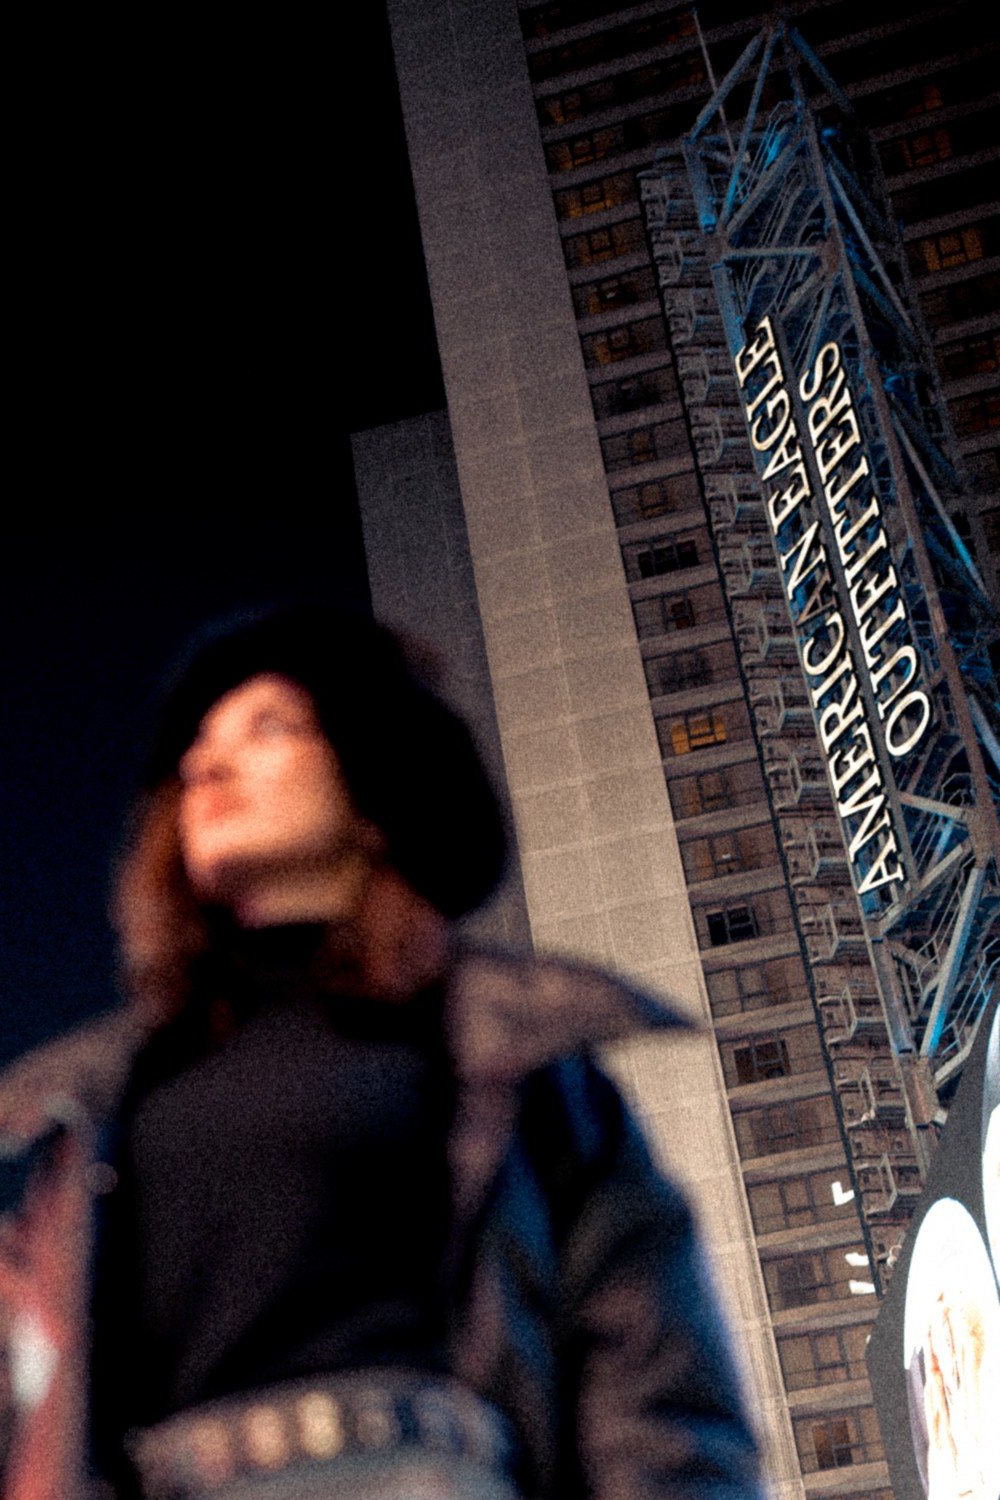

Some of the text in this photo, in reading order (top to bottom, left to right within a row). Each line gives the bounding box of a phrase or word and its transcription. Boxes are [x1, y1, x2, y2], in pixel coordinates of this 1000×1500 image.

[735, 315, 904, 895] AMERICAN EAGLE
[800, 342, 930, 757] OUTFITTERS
